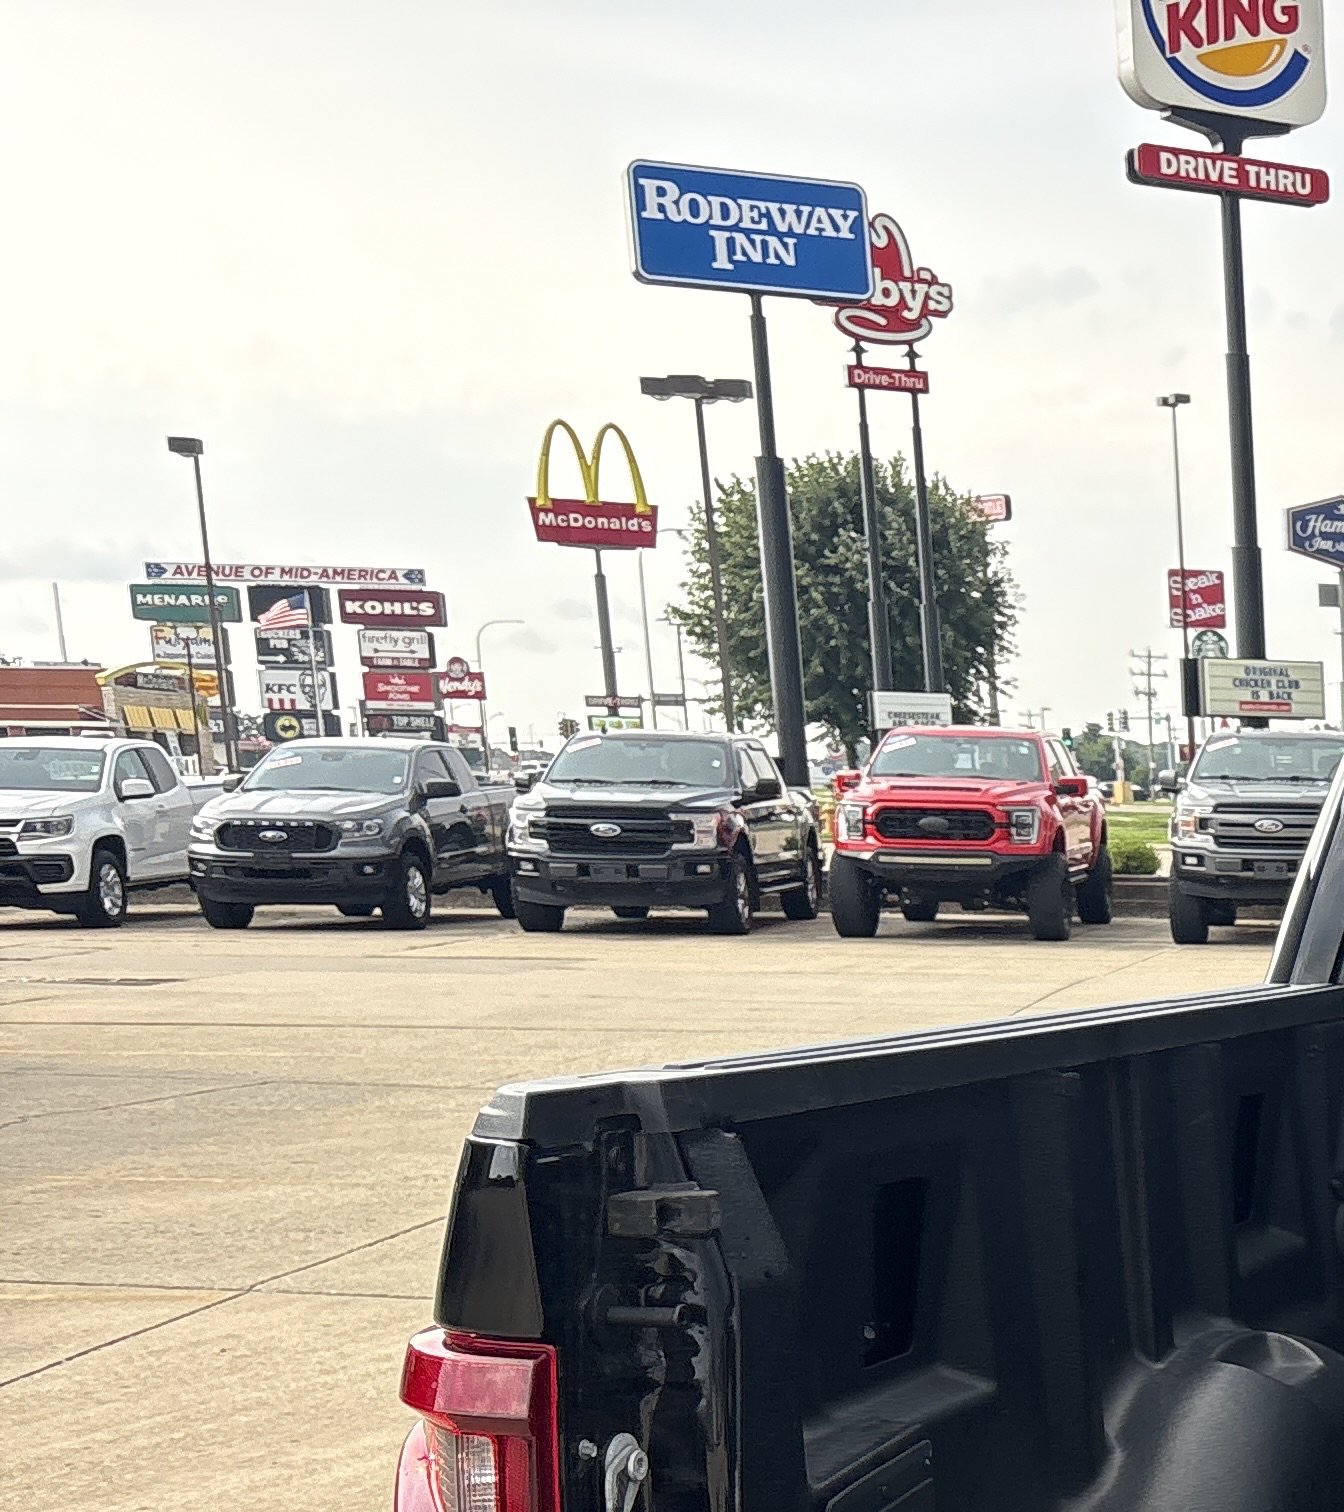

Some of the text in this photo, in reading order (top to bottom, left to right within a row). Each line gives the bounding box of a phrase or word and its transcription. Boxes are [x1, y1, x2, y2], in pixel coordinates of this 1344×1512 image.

[1166, 0, 1299, 54] KING
[1159, 152, 1312, 196] DRIVE THRU
[638, 178, 859, 240] RODEWAY
[709, 229, 797, 271] INN
[873, 267, 951, 321] by's
[853, 368, 924, 389] Drive-Thru
[538, 512, 653, 532] McDonald's
[171, 565, 400, 582] AVENUE OF MID-AMERICA
[136, 594, 228, 606] MENARS
[344, 600, 436, 616] KOHL'S
[264, 683, 297, 694] KFC
